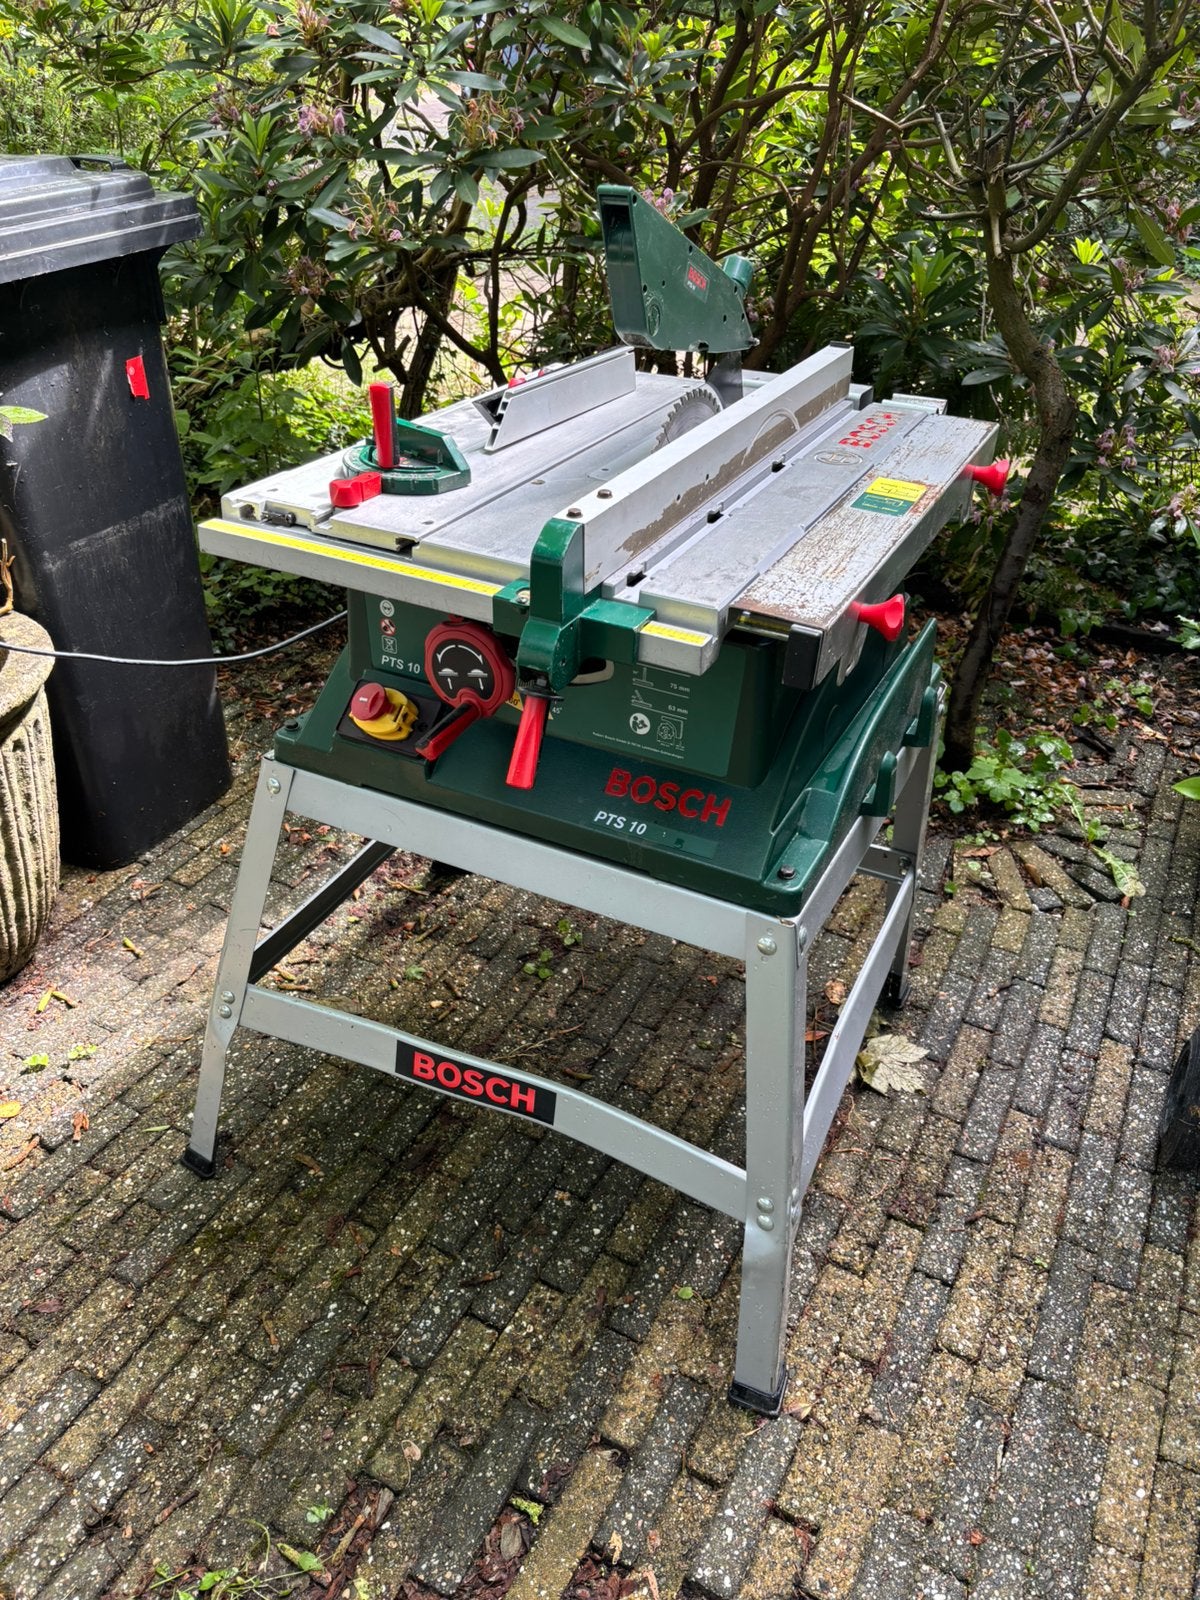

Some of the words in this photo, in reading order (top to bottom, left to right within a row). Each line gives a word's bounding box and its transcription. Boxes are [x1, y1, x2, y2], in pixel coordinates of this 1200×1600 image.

[381, 655, 404, 670] PTS
[408, 662, 421, 674] 10
[605, 769, 731, 826] BOSCH
[594, 811, 627, 829] PTS
[629, 820, 647, 835] 10
[413, 1051, 536, 1113] BOSCH
